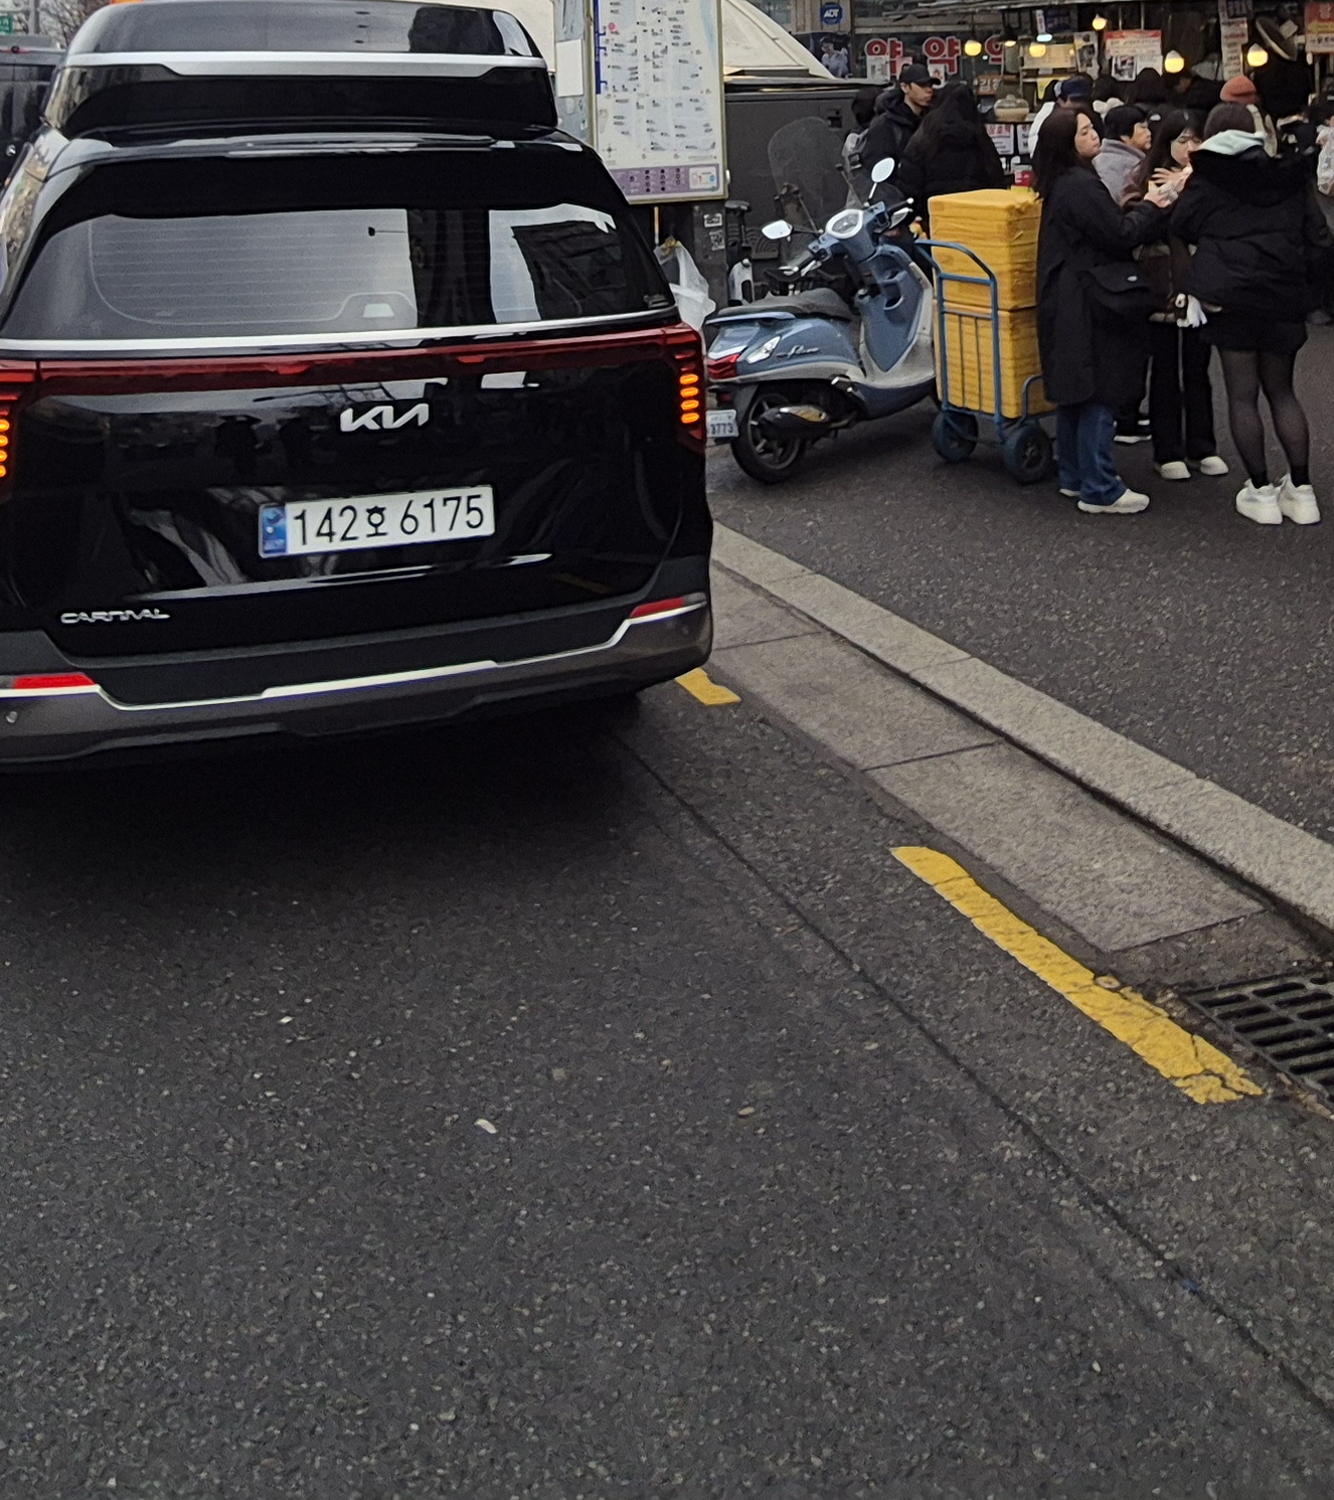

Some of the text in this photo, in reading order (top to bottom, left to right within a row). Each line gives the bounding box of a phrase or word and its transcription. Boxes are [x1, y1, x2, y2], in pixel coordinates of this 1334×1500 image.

[823, 8, 840, 19] ADT
[340, 403, 430, 433] KIA
[293, 494, 485, 546] 142호 6175
